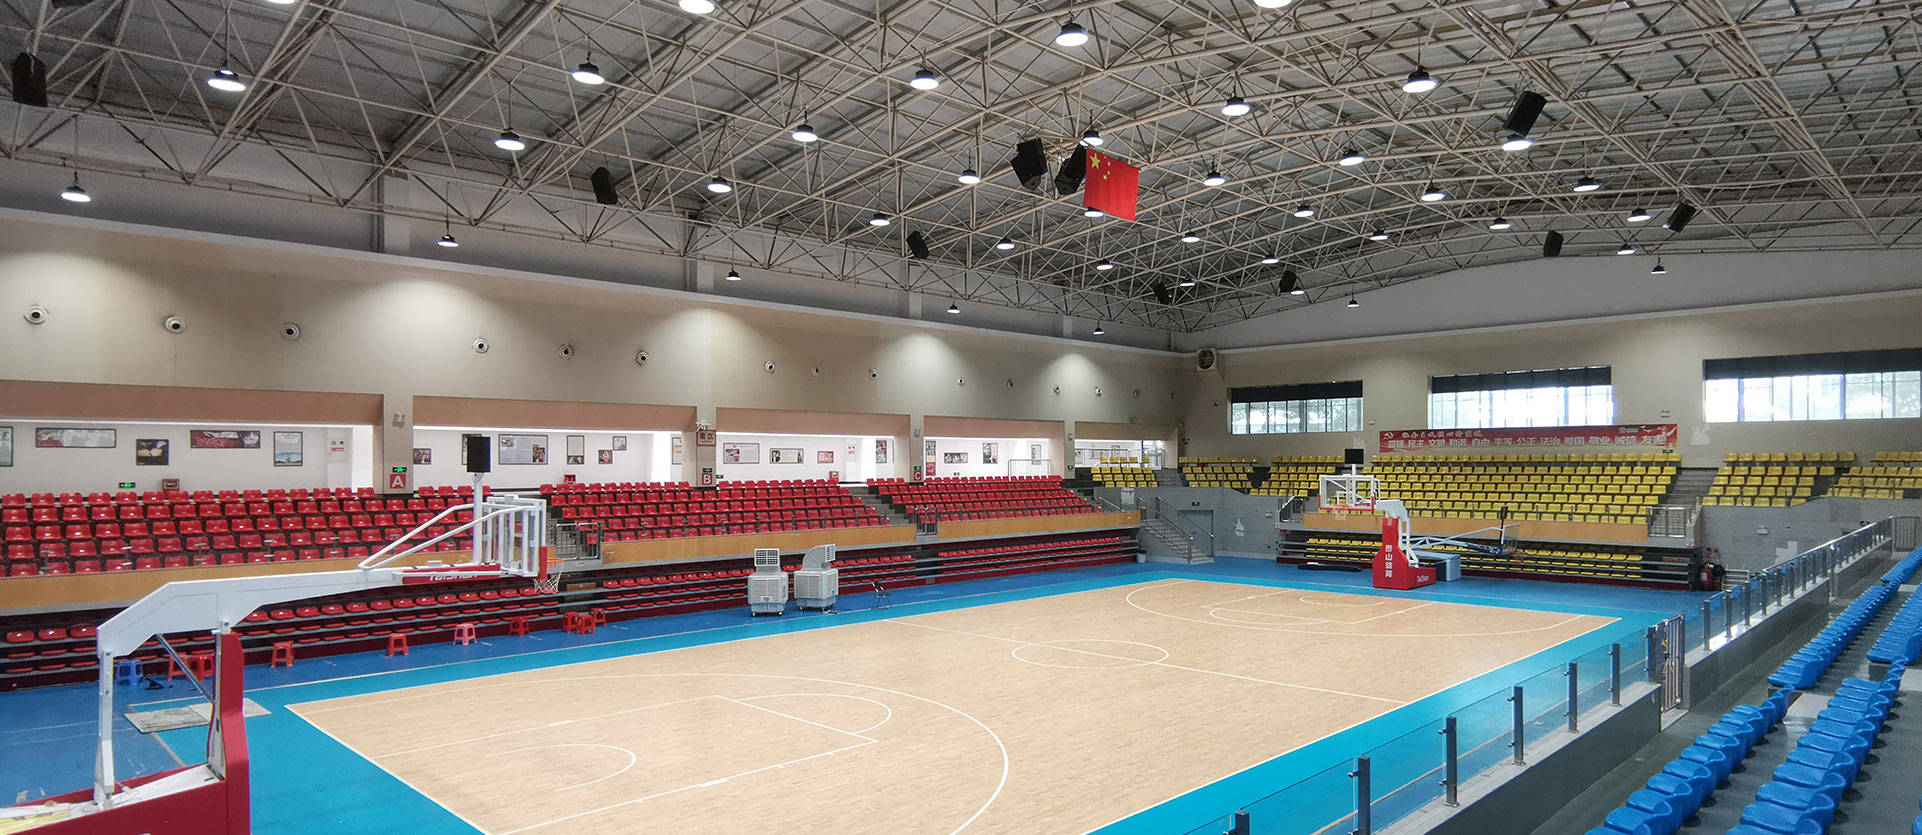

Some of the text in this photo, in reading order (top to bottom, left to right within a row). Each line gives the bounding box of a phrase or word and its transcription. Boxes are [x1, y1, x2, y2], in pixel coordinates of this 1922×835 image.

[1388, 435, 1667, 448] 富强 民主 文明 和谐 自由 平等 公正 法治 爱国 敬业 诚信 友善
[391, 475, 405, 488] A
[703, 474, 711, 484] B
